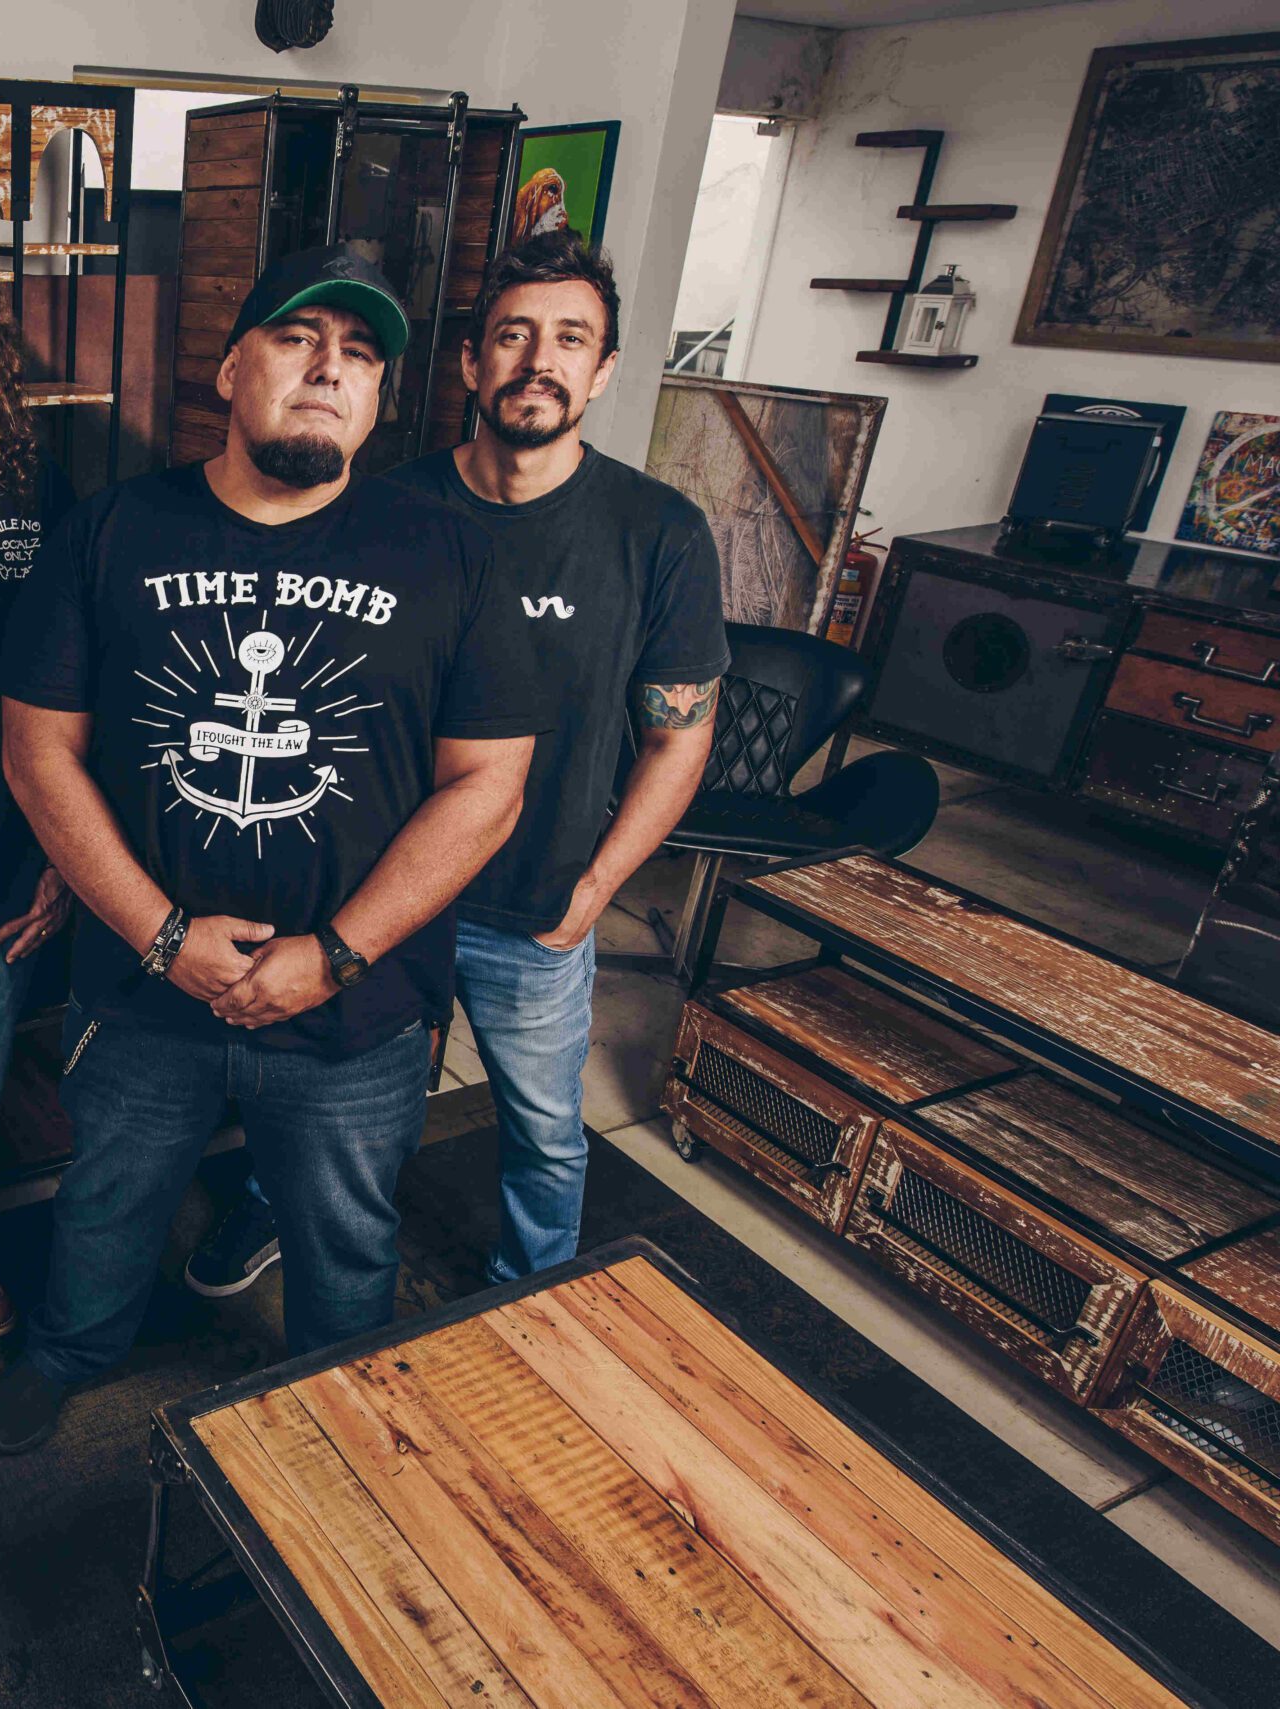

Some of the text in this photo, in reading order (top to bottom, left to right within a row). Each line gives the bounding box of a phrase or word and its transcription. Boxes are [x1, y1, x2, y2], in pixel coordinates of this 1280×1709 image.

[4, 550, 34, 561] ONLY
[144, 570, 398, 625] TIME BOMB
[203, 731, 246, 747] FOUGHT
[251, 737, 274, 749] THE
[276, 738, 303, 750] LAW
